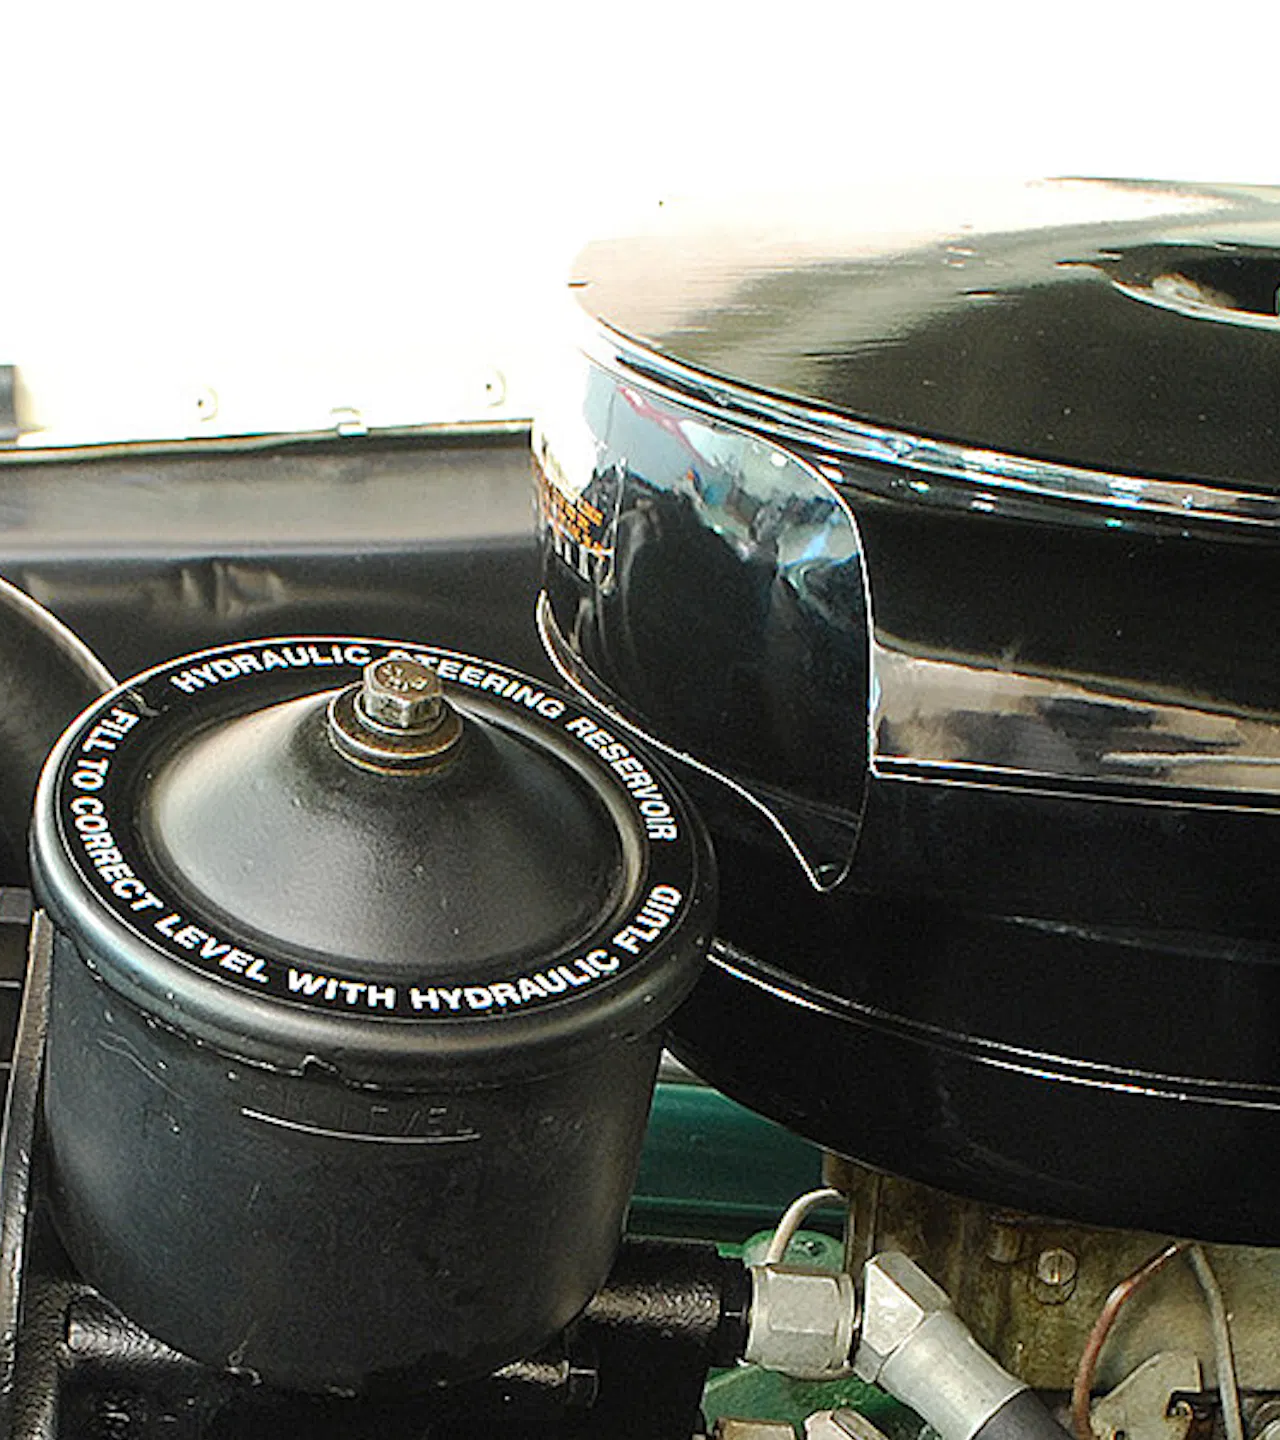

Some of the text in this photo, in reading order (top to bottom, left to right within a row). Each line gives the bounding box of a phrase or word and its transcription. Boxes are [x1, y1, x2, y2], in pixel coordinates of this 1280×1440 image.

[70, 706, 683, 1013] FILL TO CORRECT LEVEL WITH HYDRAULIC FLUID
[170, 645, 372, 693] HYDRAULIC
[565, 715, 678, 841] RESERVOIR
